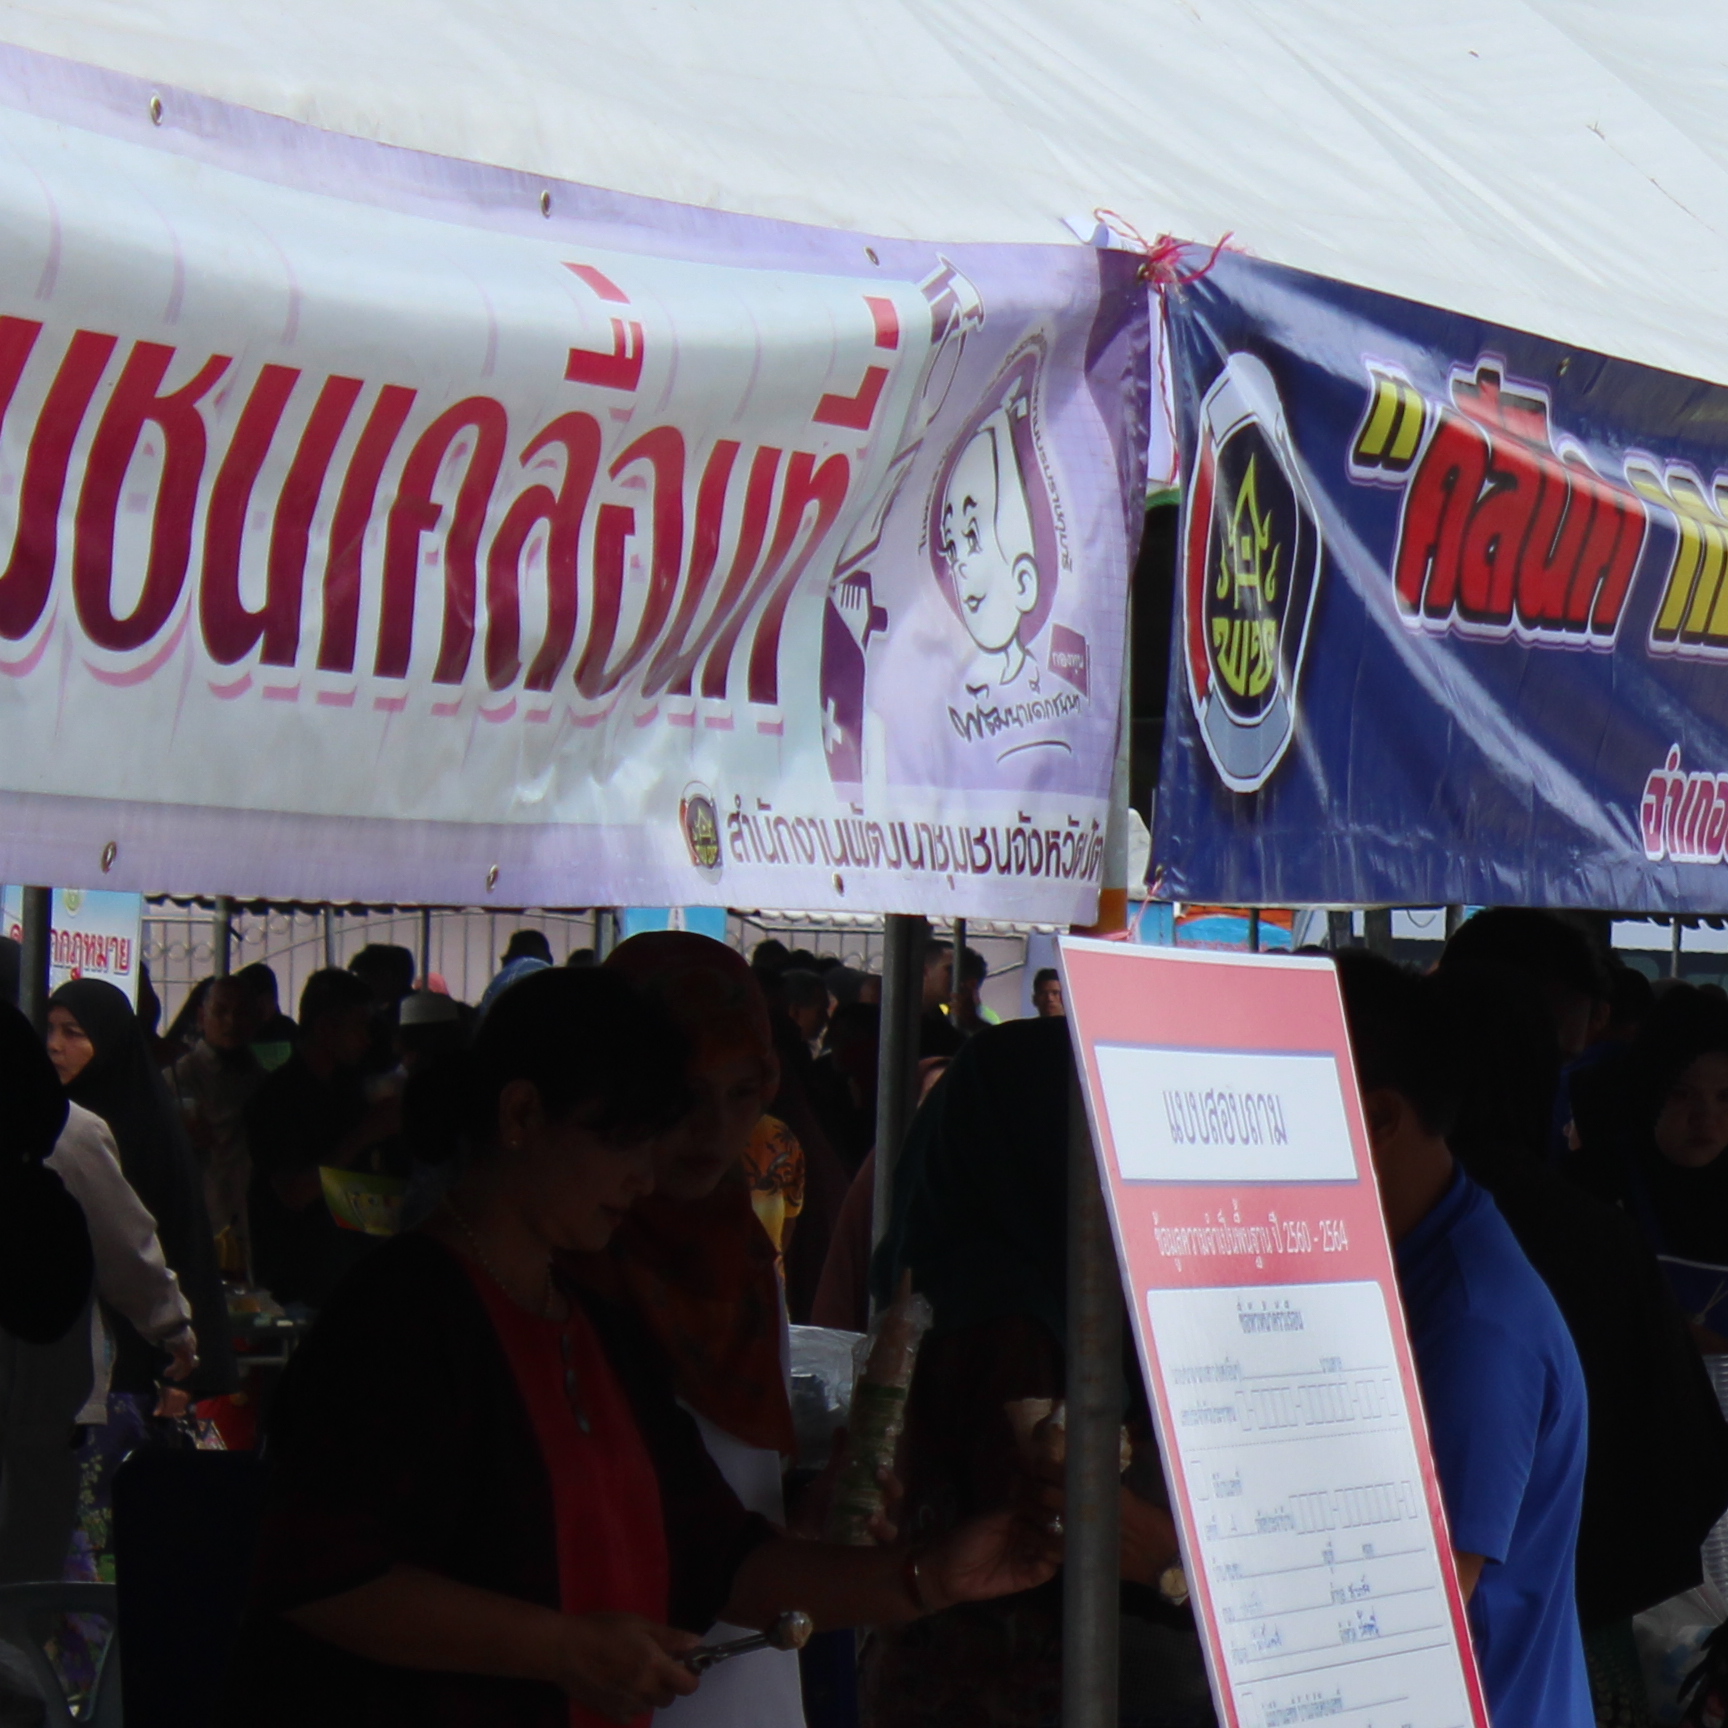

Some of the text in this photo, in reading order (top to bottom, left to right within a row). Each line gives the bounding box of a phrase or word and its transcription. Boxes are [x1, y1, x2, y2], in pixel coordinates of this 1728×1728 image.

[1162, 1088, 1288, 1145] แบบสอบถาม
[1283, 1220, 1312, 1254] 2560
[1319, 1219, 1349, 1252] 2564
